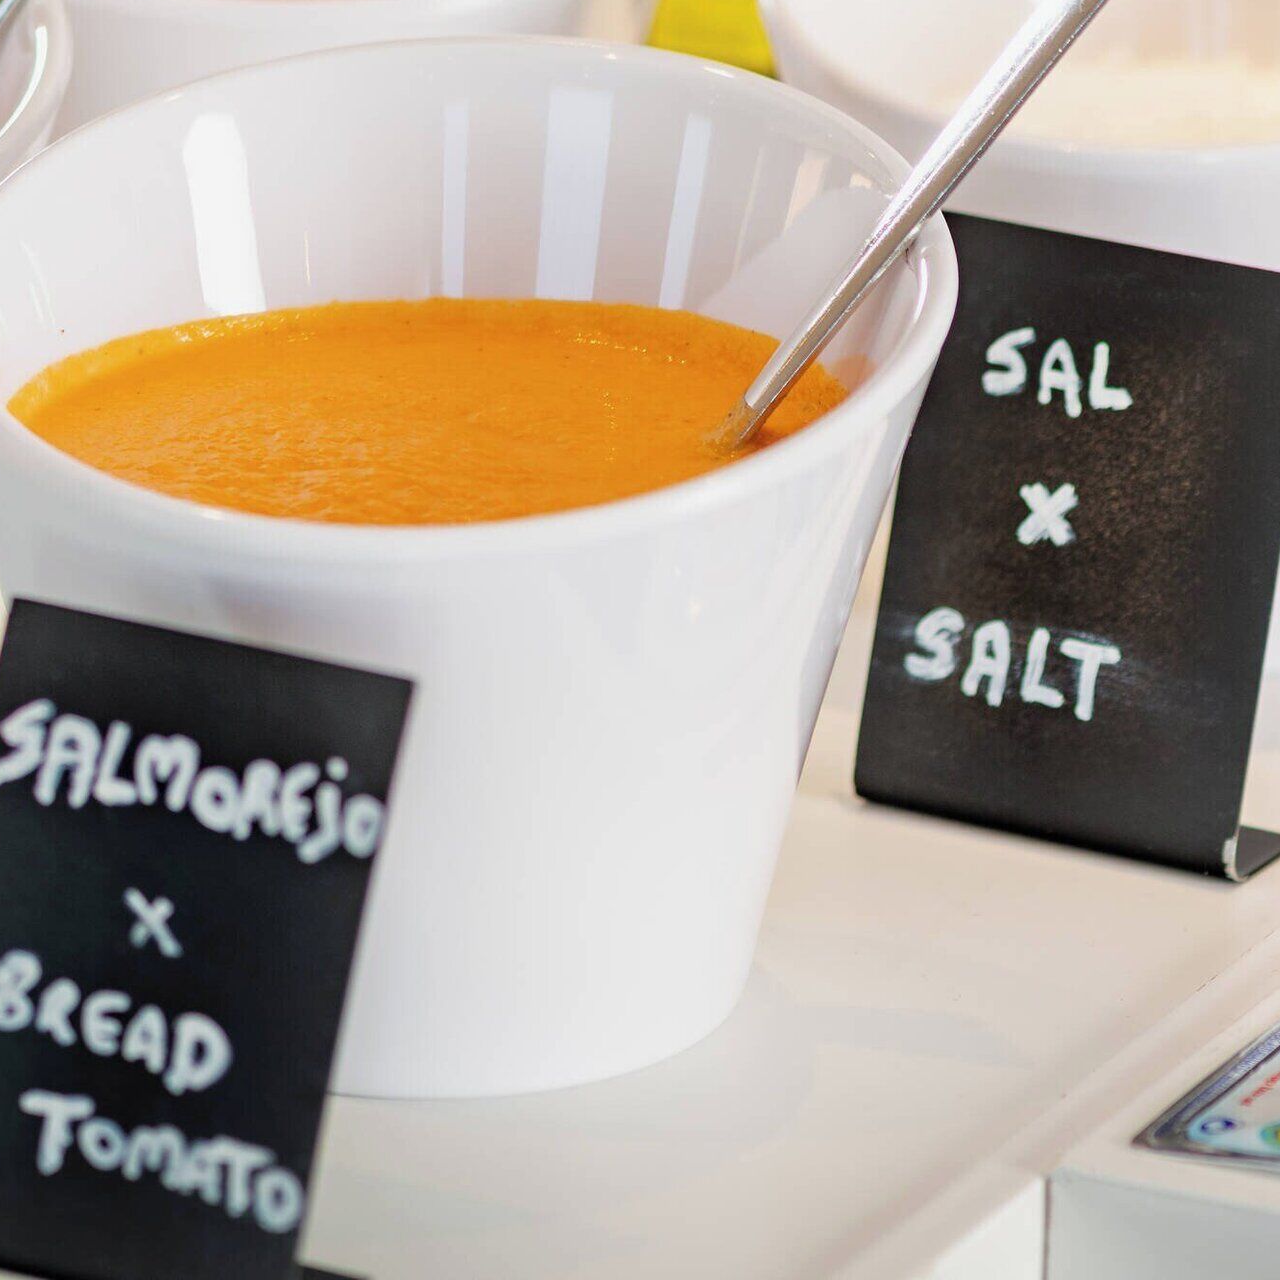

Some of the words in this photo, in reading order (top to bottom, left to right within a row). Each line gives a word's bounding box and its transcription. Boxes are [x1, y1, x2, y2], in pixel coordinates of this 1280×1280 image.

[982, 326, 1132, 418] SAL
[904, 607, 1121, 722] SALT
[20, 1088, 304, 1234] TOMATO
